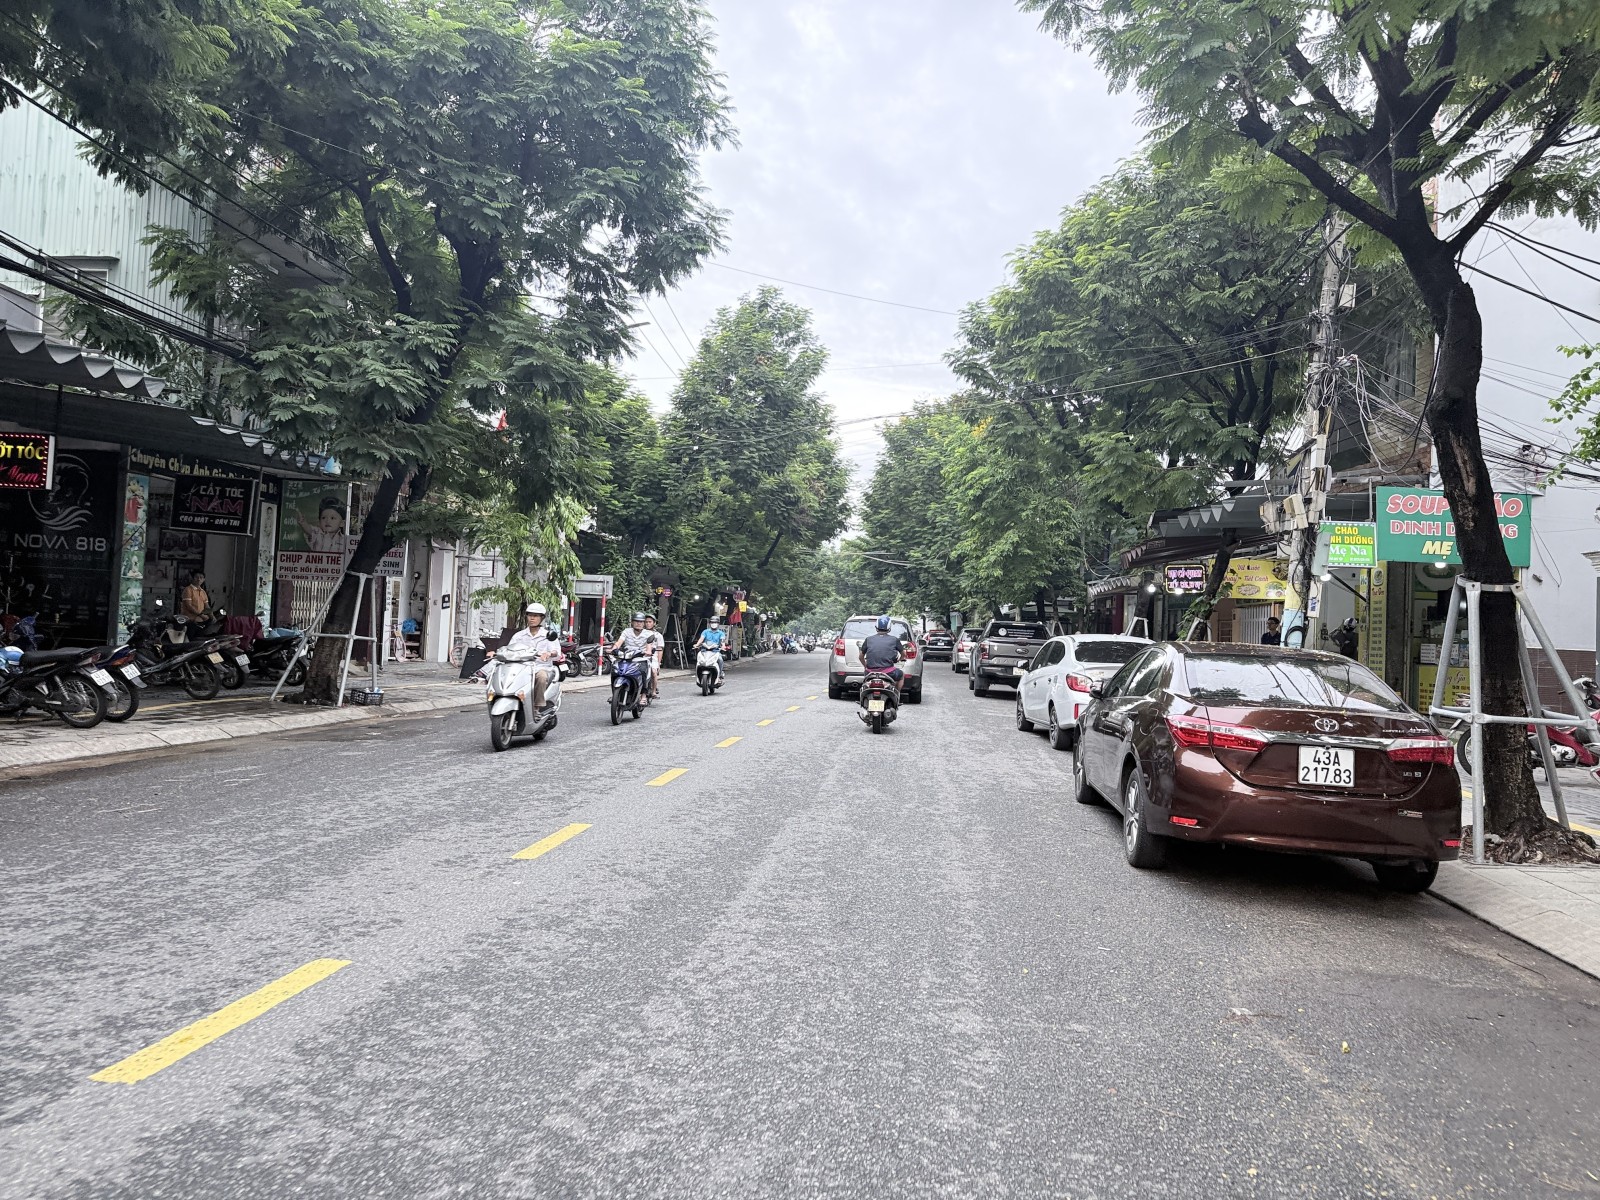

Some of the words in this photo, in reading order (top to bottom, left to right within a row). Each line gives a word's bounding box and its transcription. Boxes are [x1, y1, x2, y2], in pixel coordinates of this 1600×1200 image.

[17, 442, 45, 460] TÓC
[131, 448, 166, 468] Chuyên
[1386, 494, 1450, 515] SOUP
[1390, 520, 1441, 536] DINH
[14, 533, 69, 550] NOVA
[76, 536, 106, 551] 818
[1330, 535, 1341, 543] NH
[1329, 545, 1346, 557] Mẹ
[1350, 545, 1367, 555] Na
[1421, 540, 1454, 560] MẸ
[280, 553, 303, 566] CHỤP
[382, 560, 400, 568] SINH
[1313, 750, 1341, 766] 43A
[1301, 766, 1352, 784] 217.83
